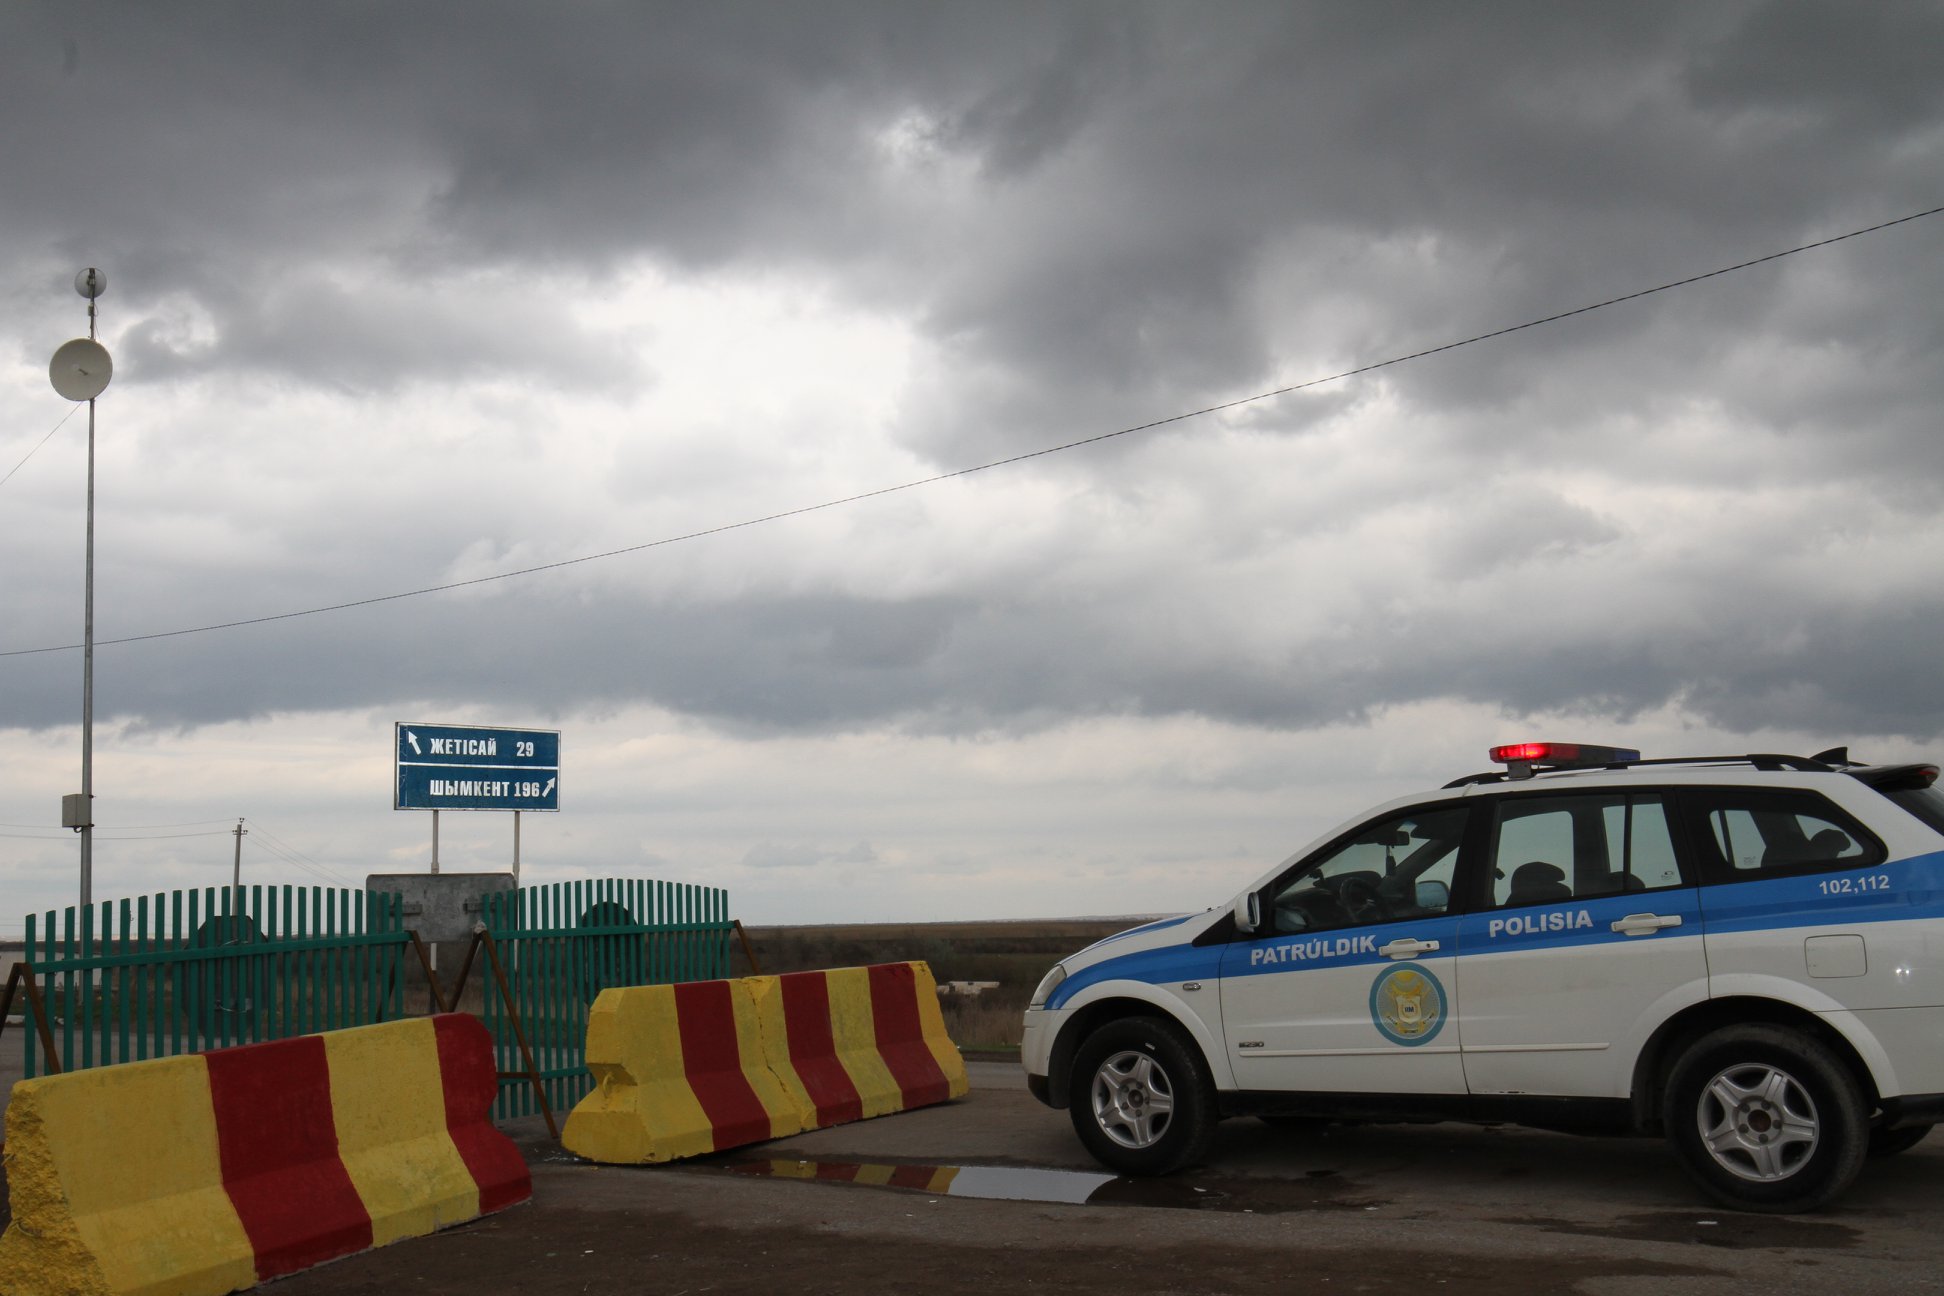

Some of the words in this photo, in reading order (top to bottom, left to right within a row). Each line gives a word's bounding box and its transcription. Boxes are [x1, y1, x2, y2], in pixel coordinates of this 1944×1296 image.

[430, 738, 497, 756] ЖЕТІСАЙ
[516, 741, 535, 757] 29
[430, 780, 511, 797] ШЫМКЕНТ
[514, 782, 540, 798] 196
[1819, 875, 1890, 895] 102,112
[1489, 910, 1594, 938] POLISIA
[1251, 934, 1377, 966] PATRÚLDIK
